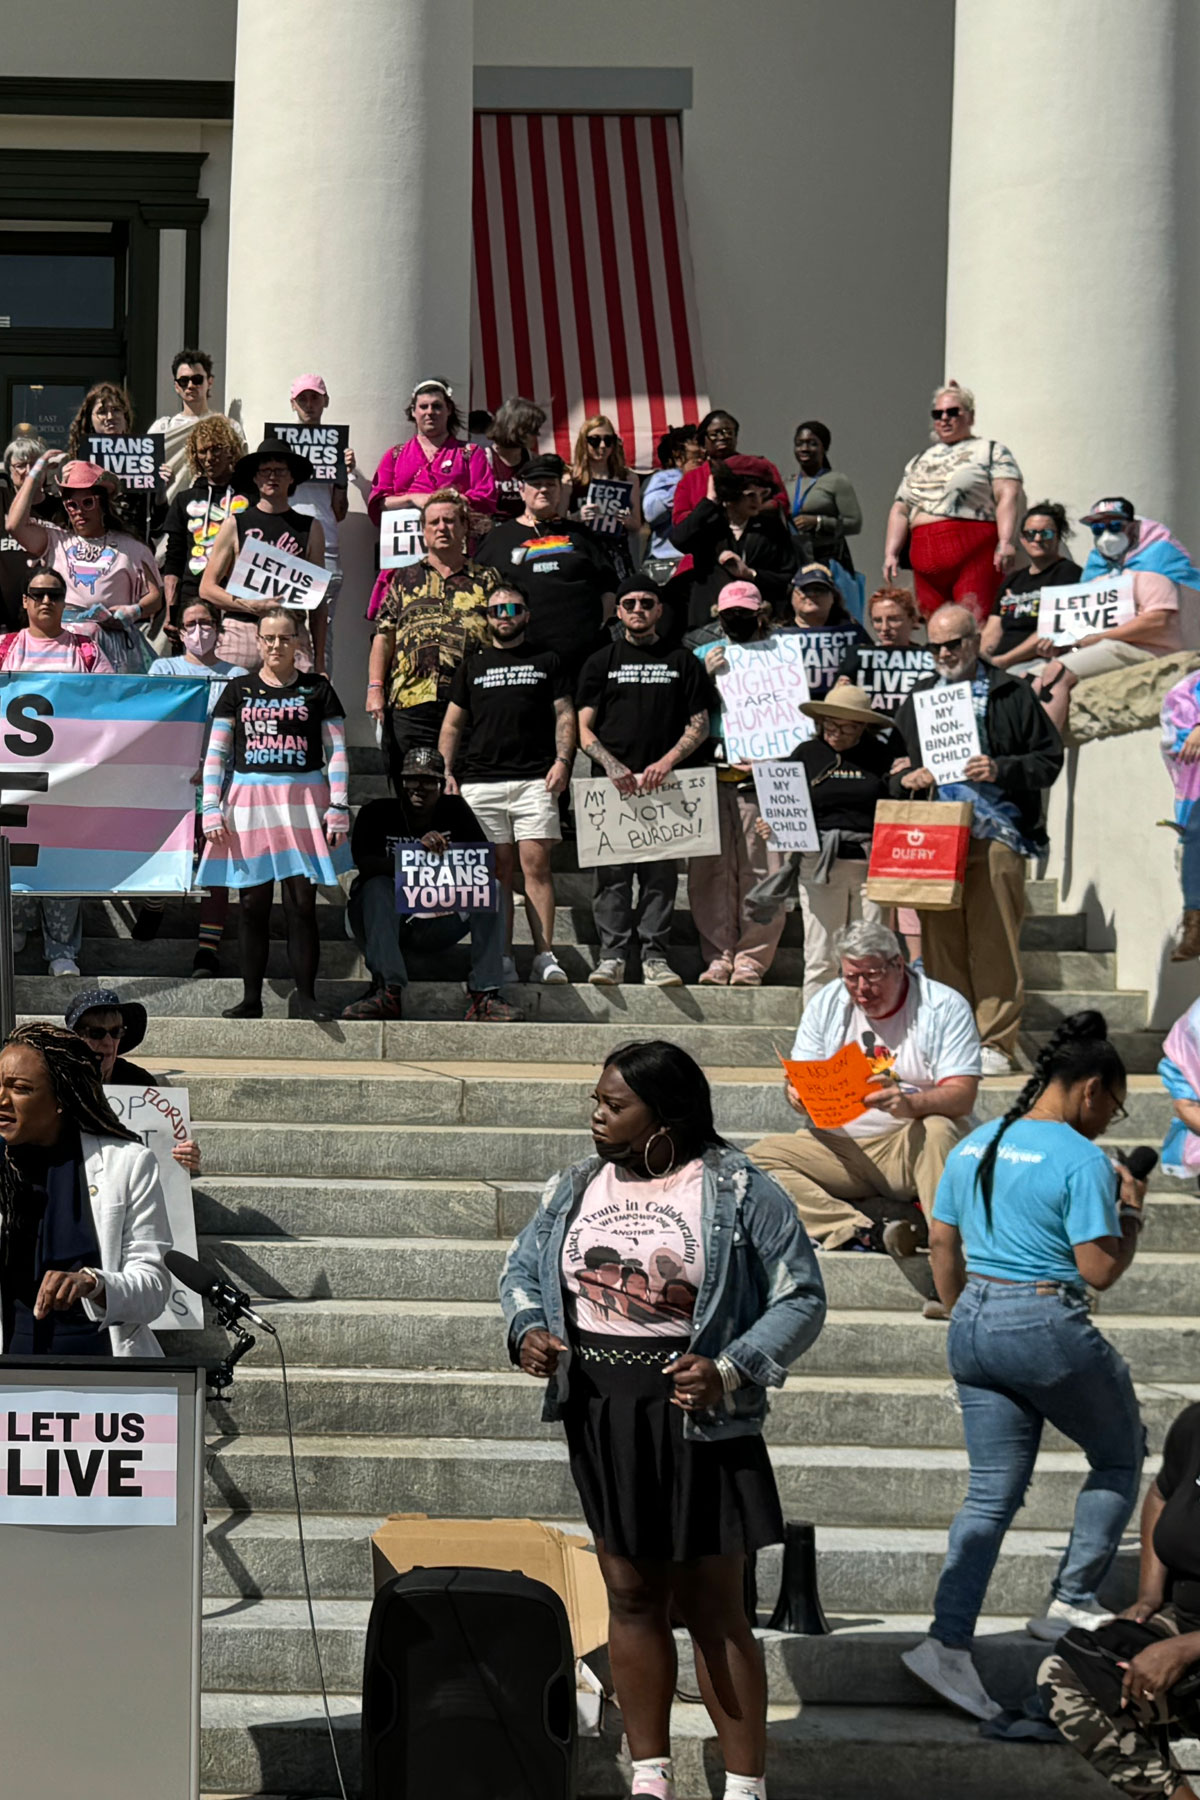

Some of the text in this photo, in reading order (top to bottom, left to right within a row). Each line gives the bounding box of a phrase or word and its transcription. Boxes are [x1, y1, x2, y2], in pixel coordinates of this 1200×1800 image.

[274, 427, 339, 445] TRANS
[88, 438, 154, 454] TRANS
[291, 445, 338, 464] VES
[252, 552, 314, 588] LET US
[243, 569, 311, 605] LIVE
[1054, 594, 1090, 611] LET
[1096, 589, 1118, 606] US
[857, 650, 936, 669] TRANS
[243, 695, 305, 708] TRANS
[744, 691, 784, 706] ARE
[920, 688, 966, 708] I LOVE
[241, 706, 309, 722] RIGHTS
[935, 706, 954, 720] MY
[245, 721, 278, 736] ARE
[930, 721, 964, 734] NON-
[246, 735, 308, 751] HUMAN
[924, 731, 973, 751] BINARY
[244, 749, 307, 766] RIGHTS
[931, 748, 971, 765] CHILD
[758, 767, 799, 778] I LOVE
[584, 790, 606, 808] MY
[689, 777, 705, 788] IS
[773, 782, 790, 790] MY
[770, 794, 800, 804] NON-
[619, 803, 671, 825] NOT
[766, 808, 808, 818] BINARY
[772, 822, 807, 832] CHILD
[597, 818, 702, 856] A BURDEN!
[401, 849, 489, 866] PROTECT
[402, 866, 489, 887] TRANS
[402, 886, 490, 908] YOUTH
[566, 1199, 700, 1264] Black Trans in Collaboration
[8, 1412, 144, 1442] LET US
[7, 1449, 142, 1497] LIVE
